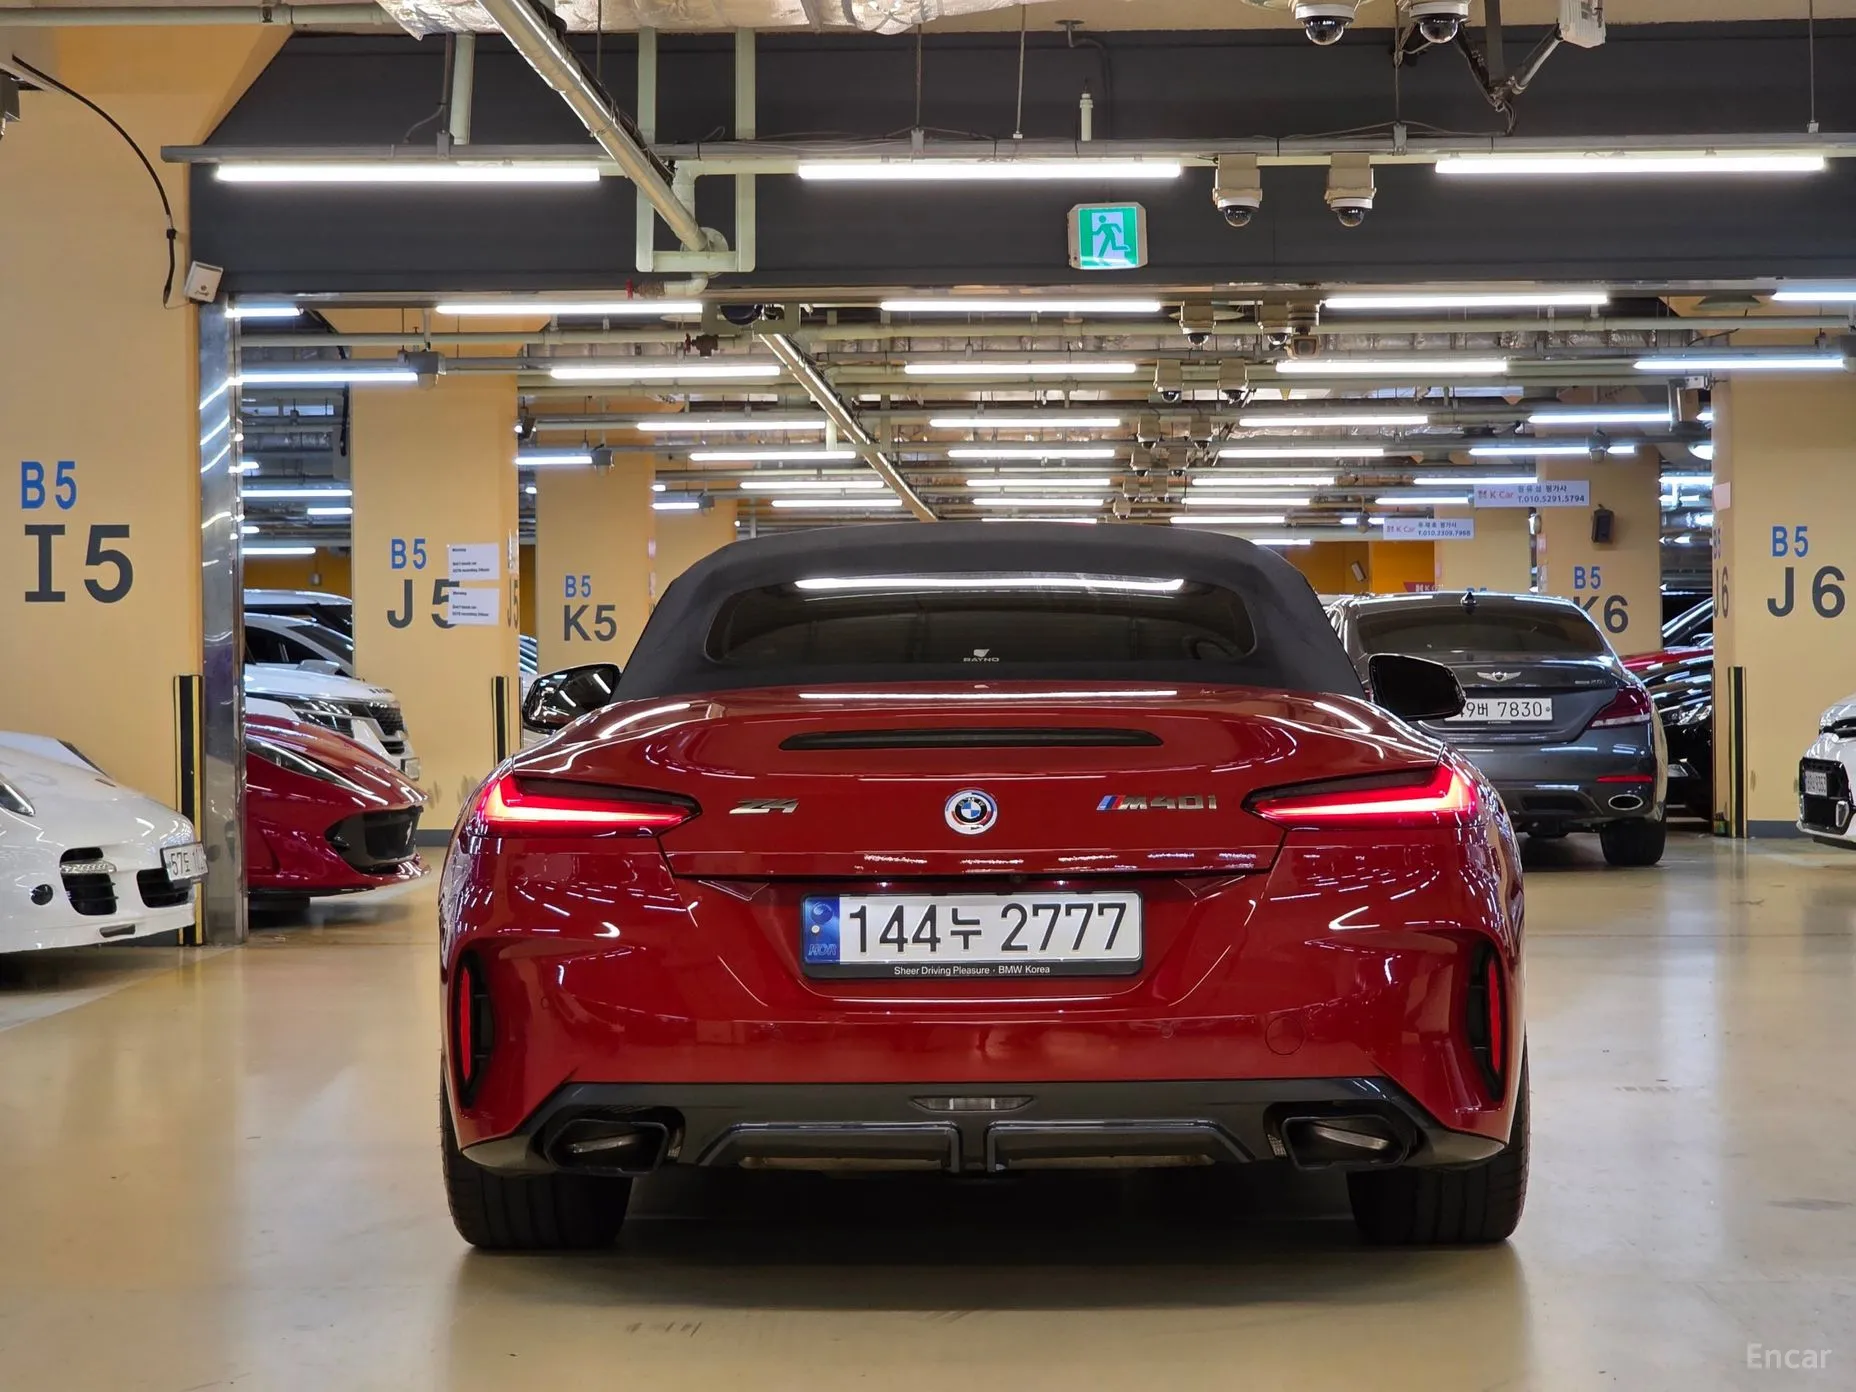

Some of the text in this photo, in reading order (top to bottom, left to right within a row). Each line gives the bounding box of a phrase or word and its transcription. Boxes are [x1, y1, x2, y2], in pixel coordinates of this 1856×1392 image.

[21, 461, 77, 510] B5
[391, 538, 427, 570] B5
[1772, 525, 1808, 558] B5
[25, 524, 133, 603] I5
[1574, 566, 1602, 590] B5
[565, 575, 592, 598] B5
[1767, 565, 1846, 619] J6
[563, 604, 617, 642] K5
[1497, 701, 1543, 718] 7830
[729, 798, 799, 814] Z4
[849, 902, 1128, 954] 144누 2777
[894, 965, 1051, 977] Sheer Driving Pleasure BMW Korea
